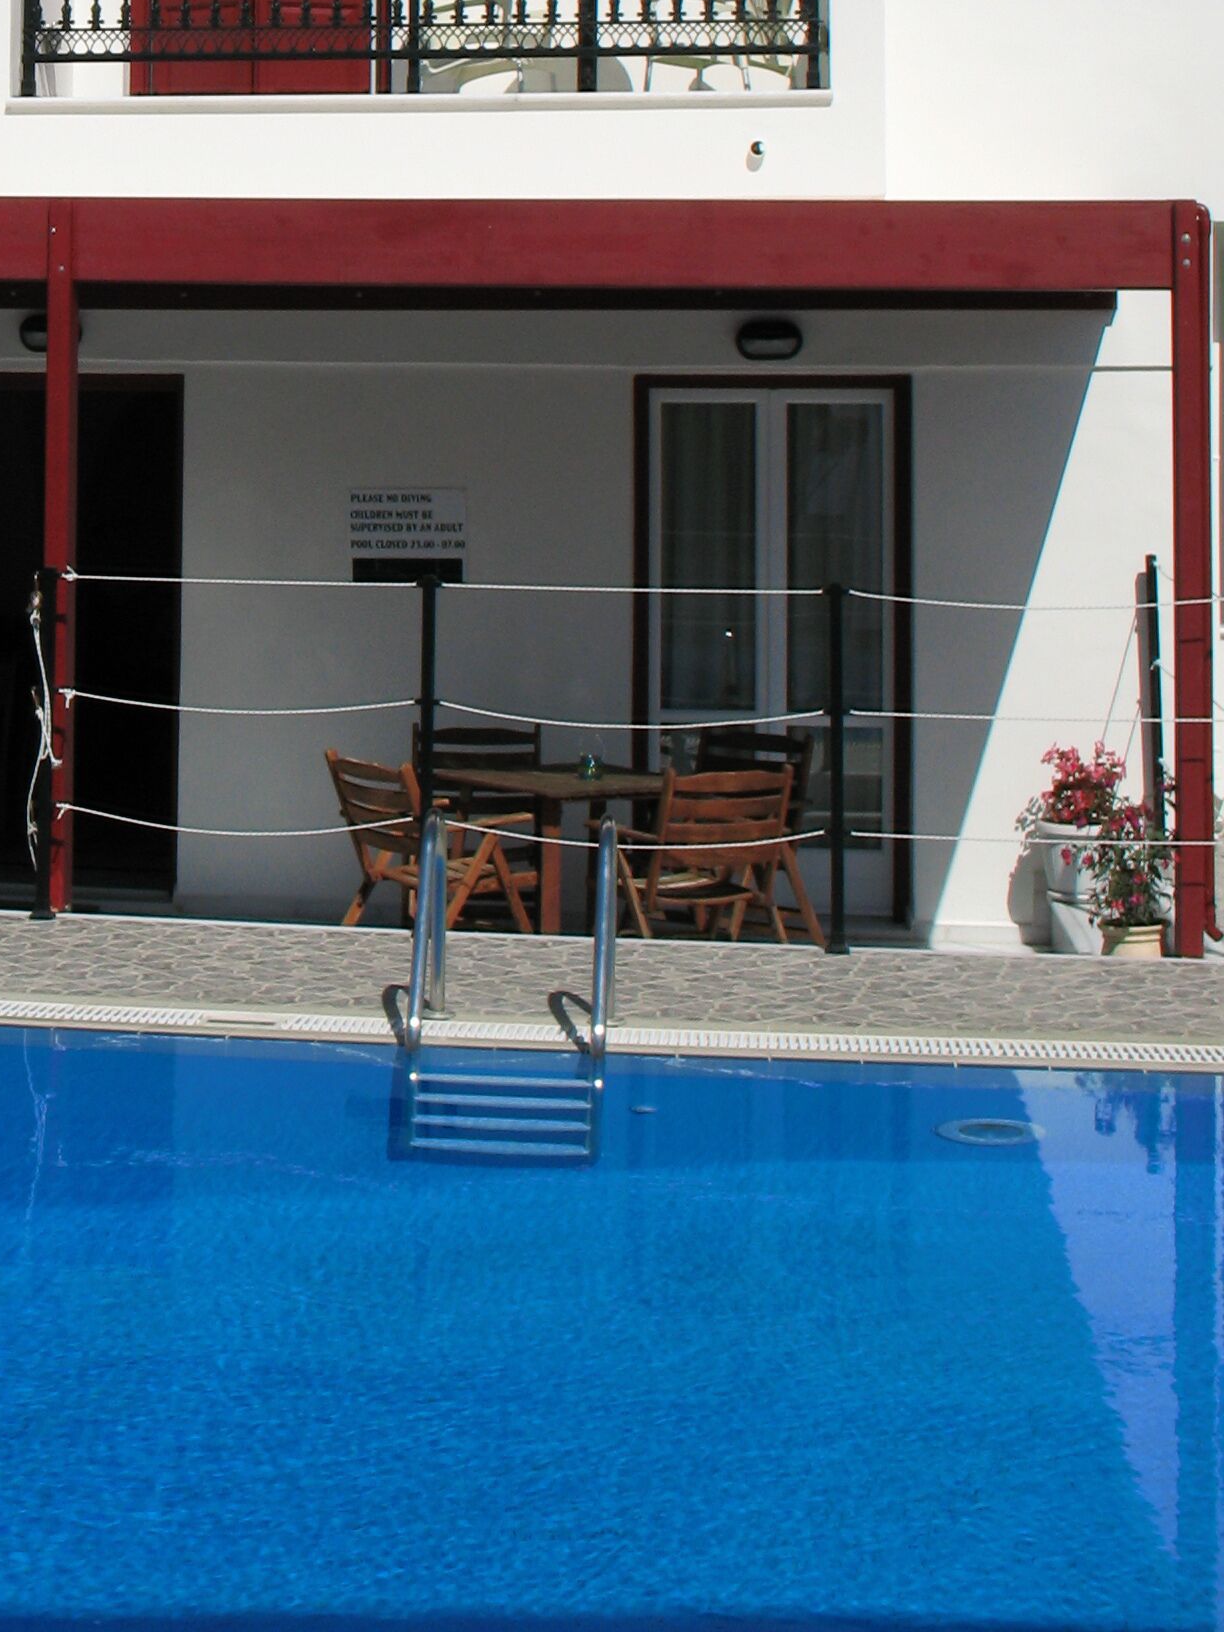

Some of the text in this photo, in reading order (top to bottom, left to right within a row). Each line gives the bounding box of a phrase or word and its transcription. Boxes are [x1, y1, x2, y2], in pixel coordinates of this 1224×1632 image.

[350, 494, 383, 503] PLEASE
[401, 494, 432, 503] DIVING
[350, 510, 393, 519] CHILDREN
[396, 510, 419, 519] MUST
[350, 523, 463, 532] SUPERVISED BY AN ADULT
[350, 540, 373, 548] POOL
[376, 540, 408, 548] CLOSED
